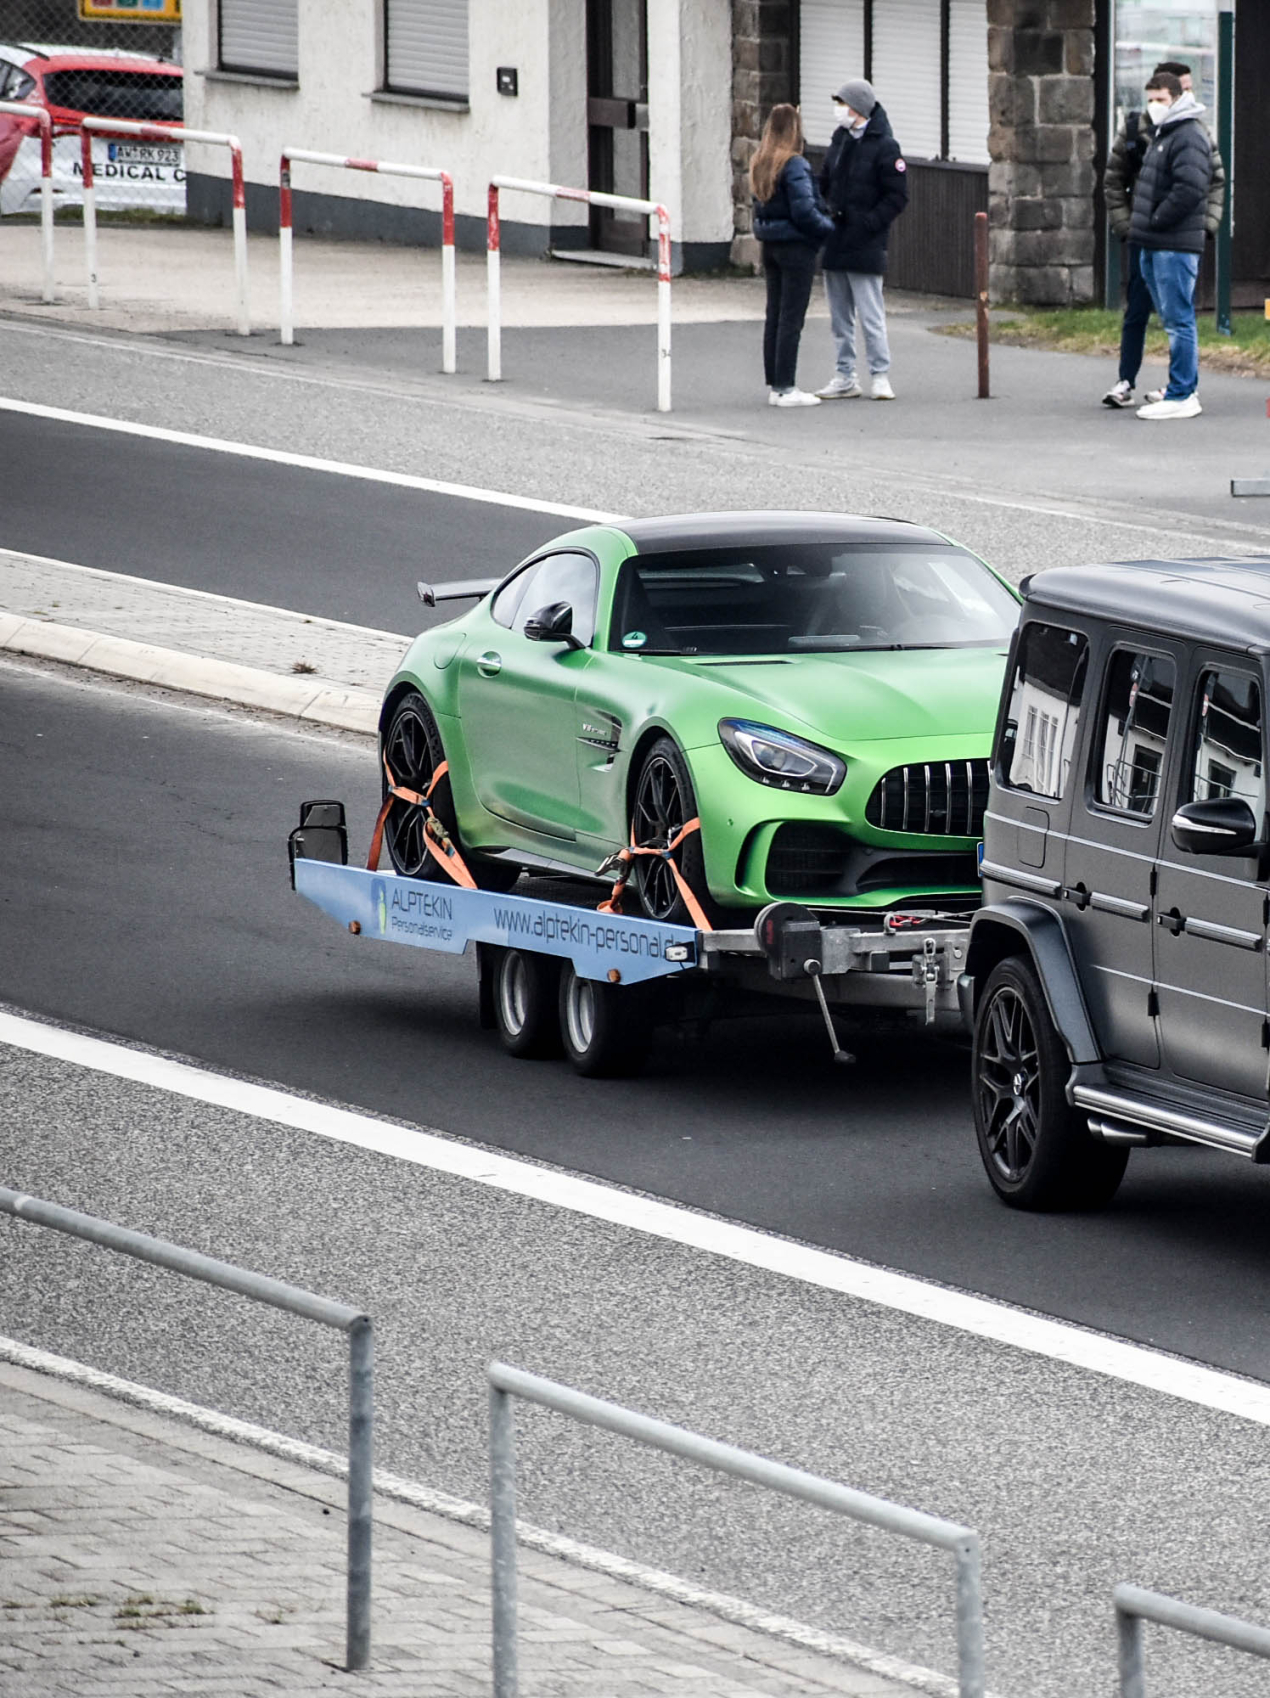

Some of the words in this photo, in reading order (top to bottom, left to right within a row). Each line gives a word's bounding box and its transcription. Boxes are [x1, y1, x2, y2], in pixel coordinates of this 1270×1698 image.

[157, 149, 180, 162] 923
[391, 888, 453, 920] ALPTEKIN
[391, 916, 453, 941] Personalservice
